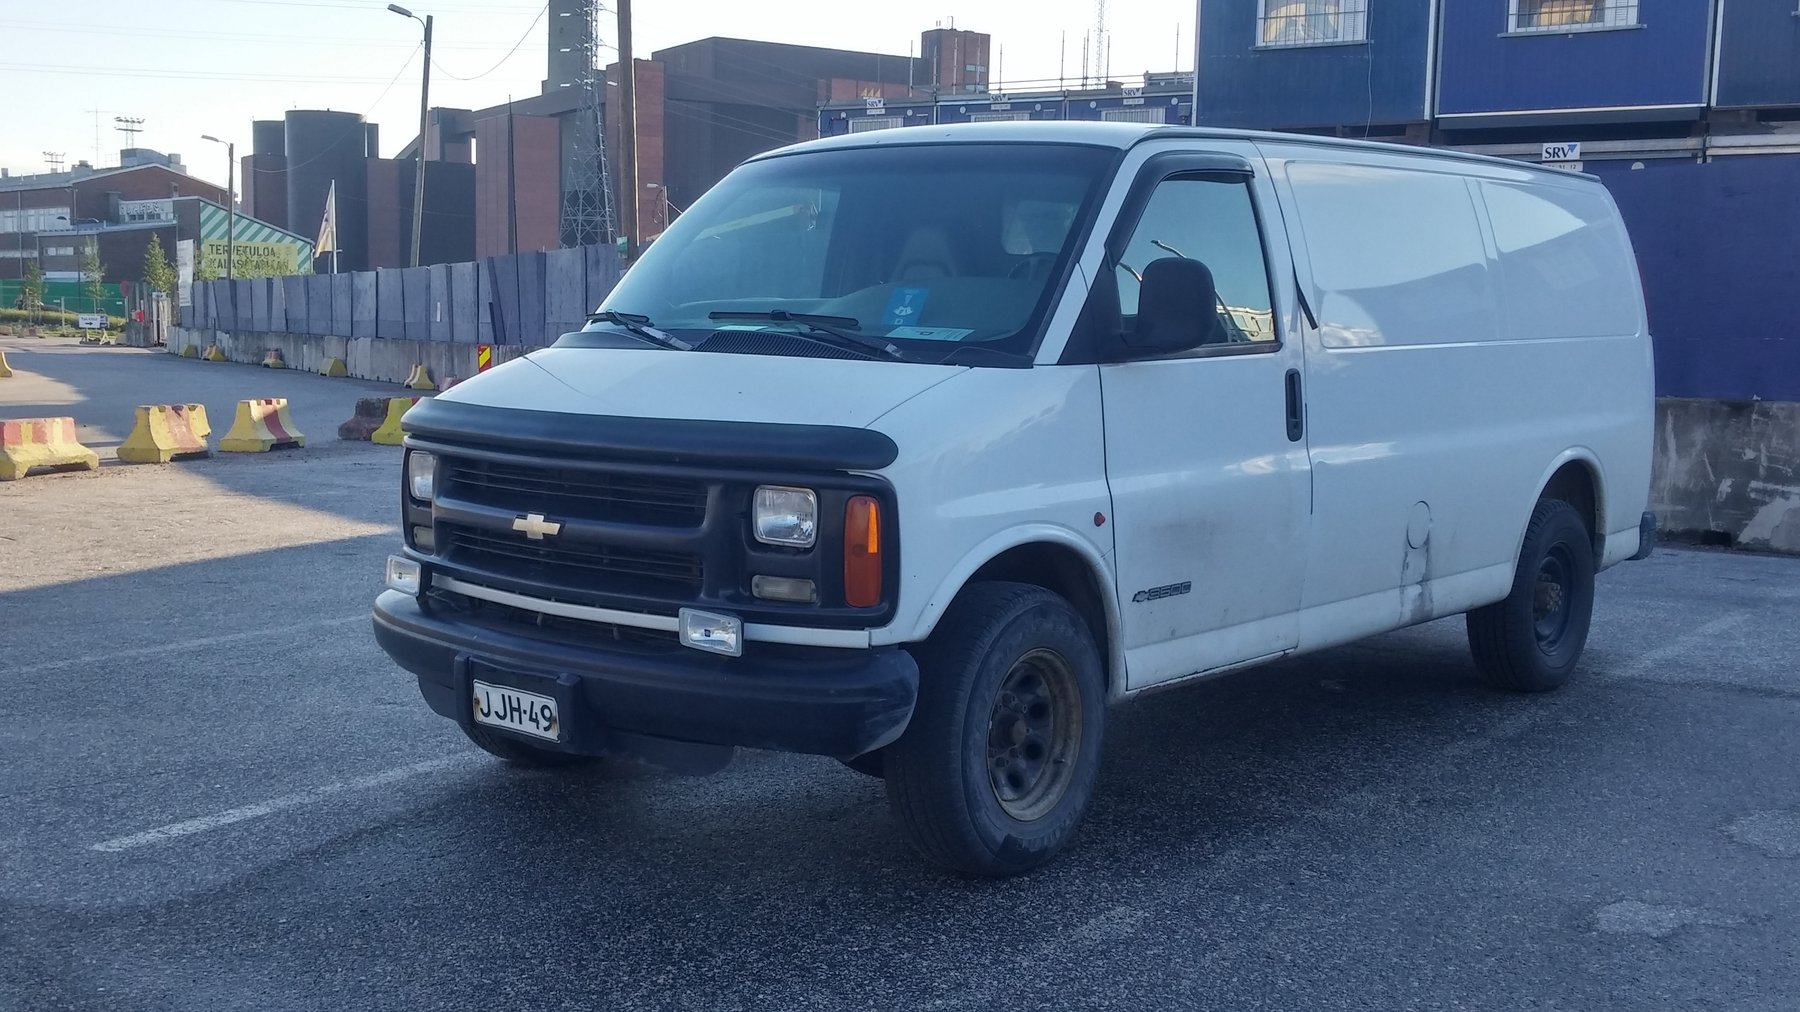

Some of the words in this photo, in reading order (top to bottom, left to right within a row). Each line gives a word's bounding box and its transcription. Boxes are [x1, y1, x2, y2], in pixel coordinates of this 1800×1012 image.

[1123, 88, 1137, 96] SRV
[1544, 146, 1570, 159] SRV
[480, 691, 553, 732] JJH-49
